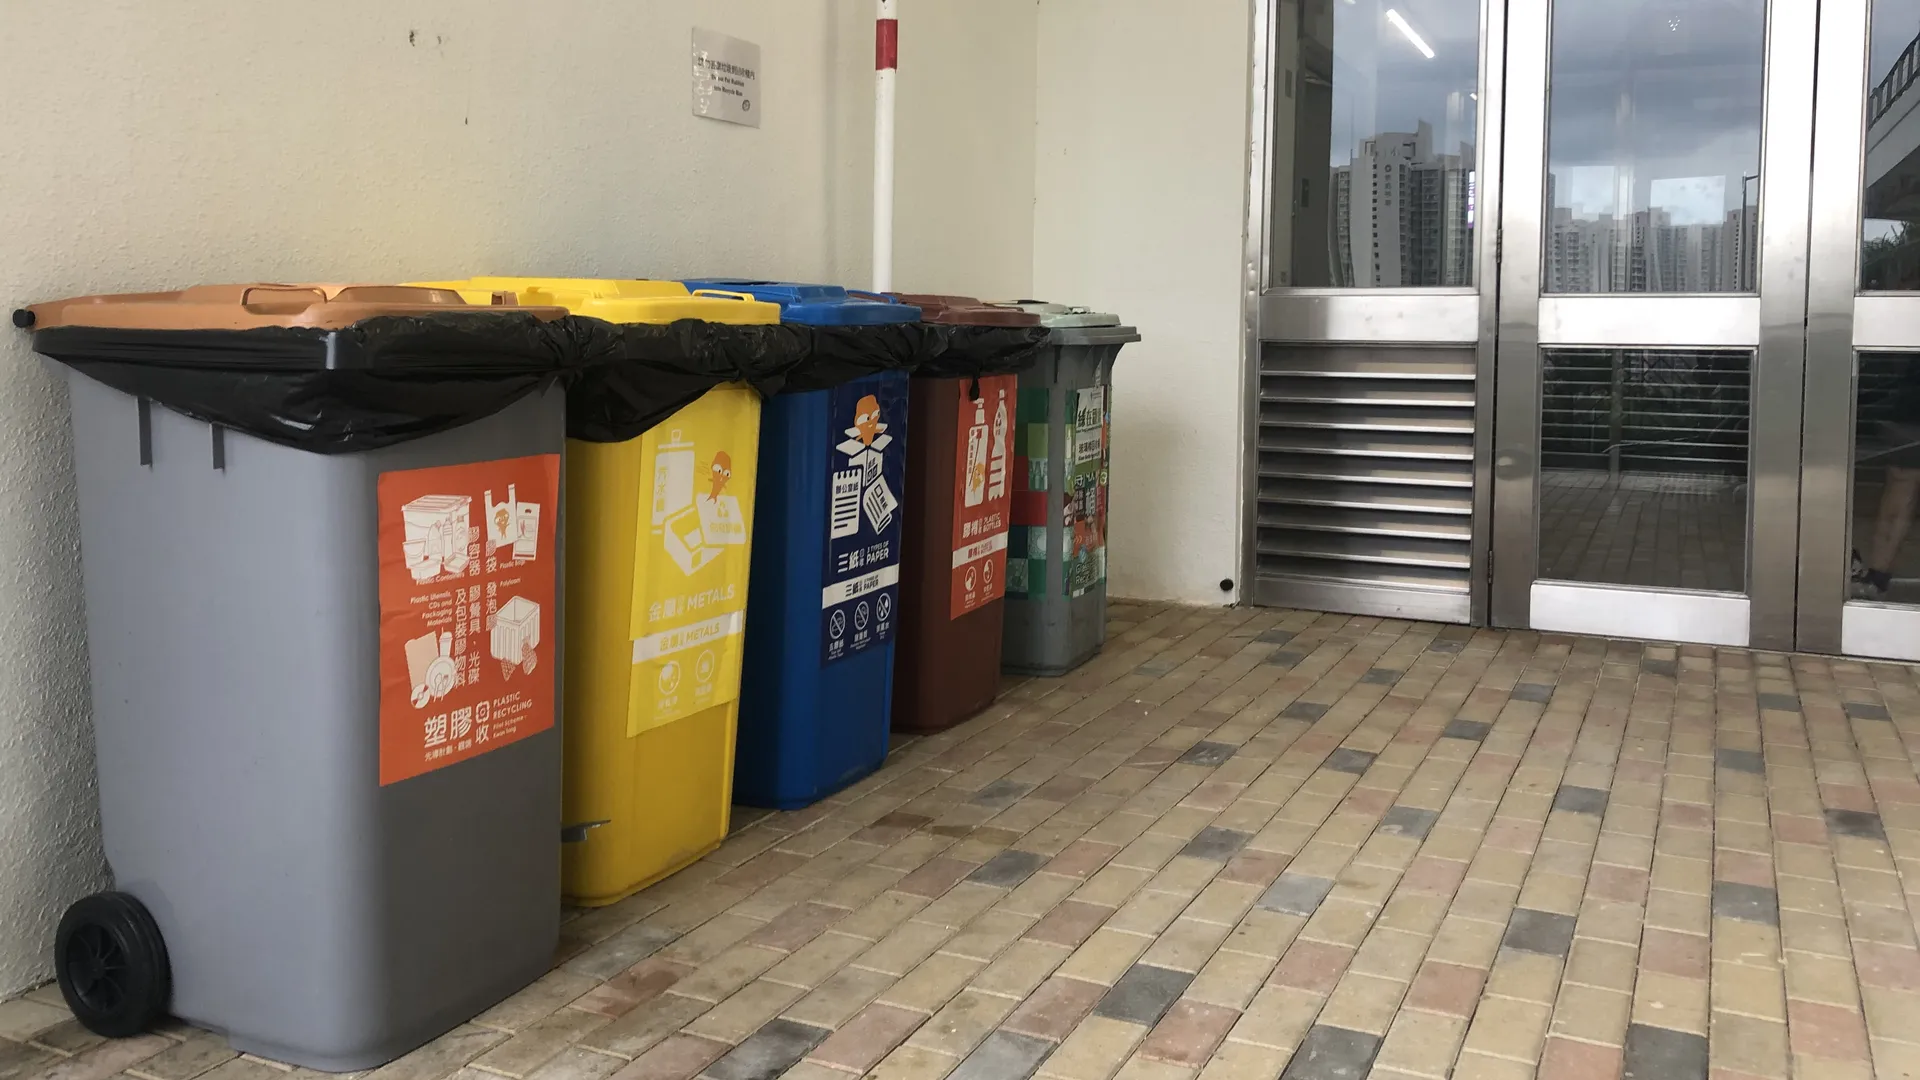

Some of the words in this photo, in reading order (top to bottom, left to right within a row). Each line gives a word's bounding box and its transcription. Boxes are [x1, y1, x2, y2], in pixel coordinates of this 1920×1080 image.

[835, 481, 859, 495] 辦公室紙
[983, 512, 1001, 524] PLASTIC
[983, 519, 1001, 533] BOTTLES
[866, 547, 889, 565] PAPER
[863, 579, 879, 591] PAPER
[410, 595, 429, 605] Plastic
[687, 583, 735, 612] METALS
[428, 602, 441, 610] CDs
[422, 608, 452, 619] Packaging
[427, 616, 452, 627] Materials
[686, 622, 720, 643] METALS
[493, 691, 520, 708] PLASTIC
[493, 699, 532, 720] RECYCLING
[424, 706, 472, 748] 塑膠
